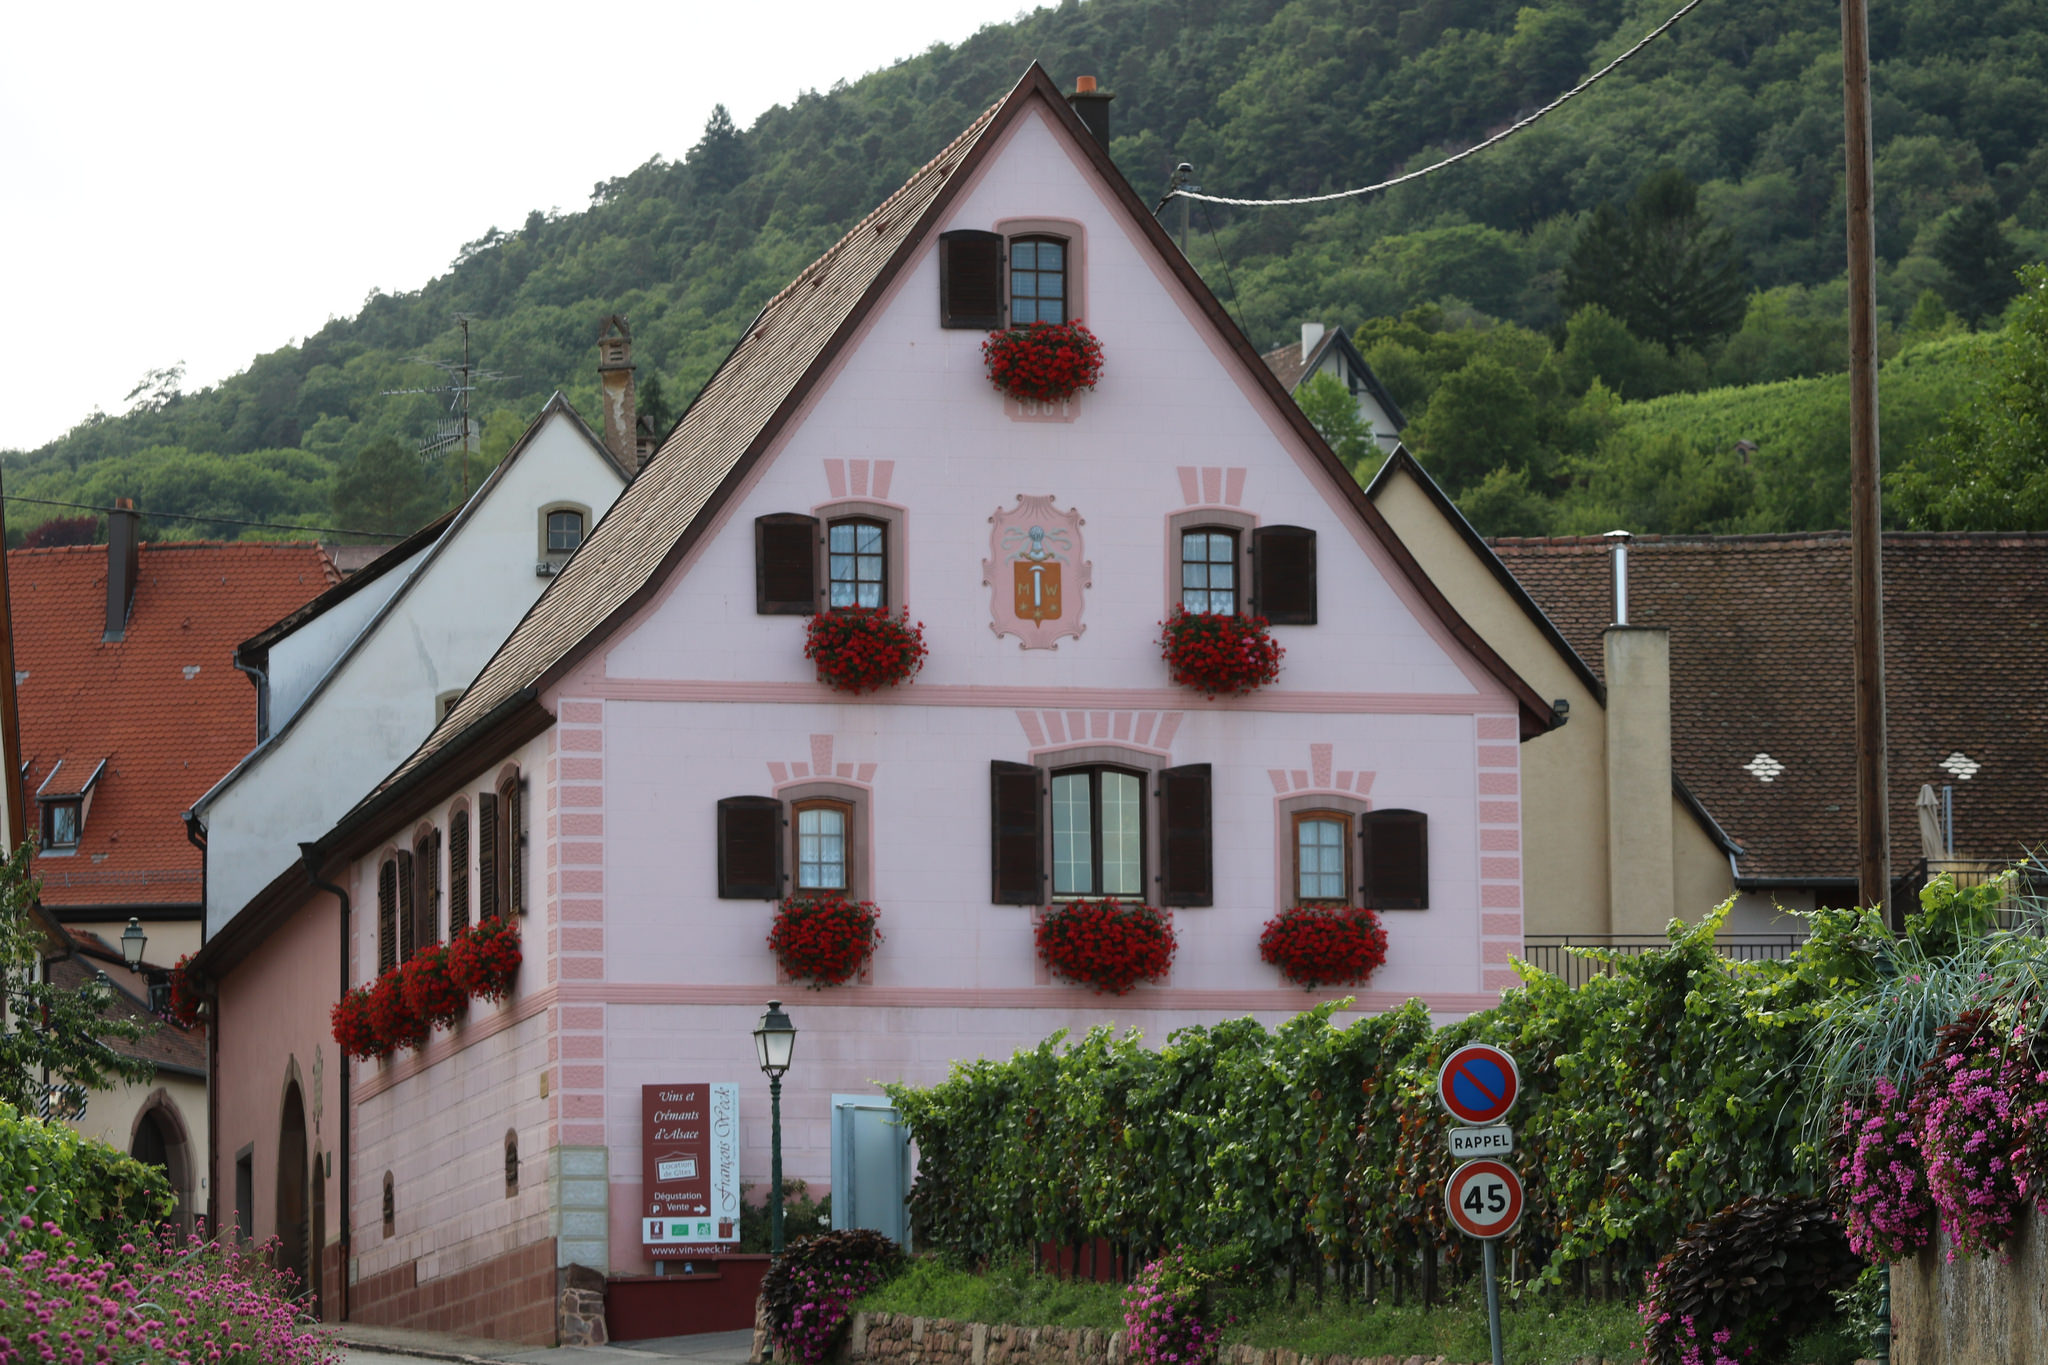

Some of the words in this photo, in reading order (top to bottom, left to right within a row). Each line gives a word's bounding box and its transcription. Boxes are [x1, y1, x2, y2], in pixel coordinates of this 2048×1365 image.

[1018, 583, 1030, 596] M
[1045, 583, 1059, 596] W
[659, 1089, 683, 1102] Vins
[685, 1091, 695, 1101] et
[654, 1109, 700, 1123] Crémants
[714, 1087, 731, 1138] Weck
[1454, 1134, 1510, 1150] RAPPEL
[661, 1161, 693, 1170] Location
[714, 1141, 736, 1212] François
[654, 1191, 702, 1202] Dégustation
[1463, 1183, 1506, 1214] 45
[666, 1203, 690, 1211] Vente
